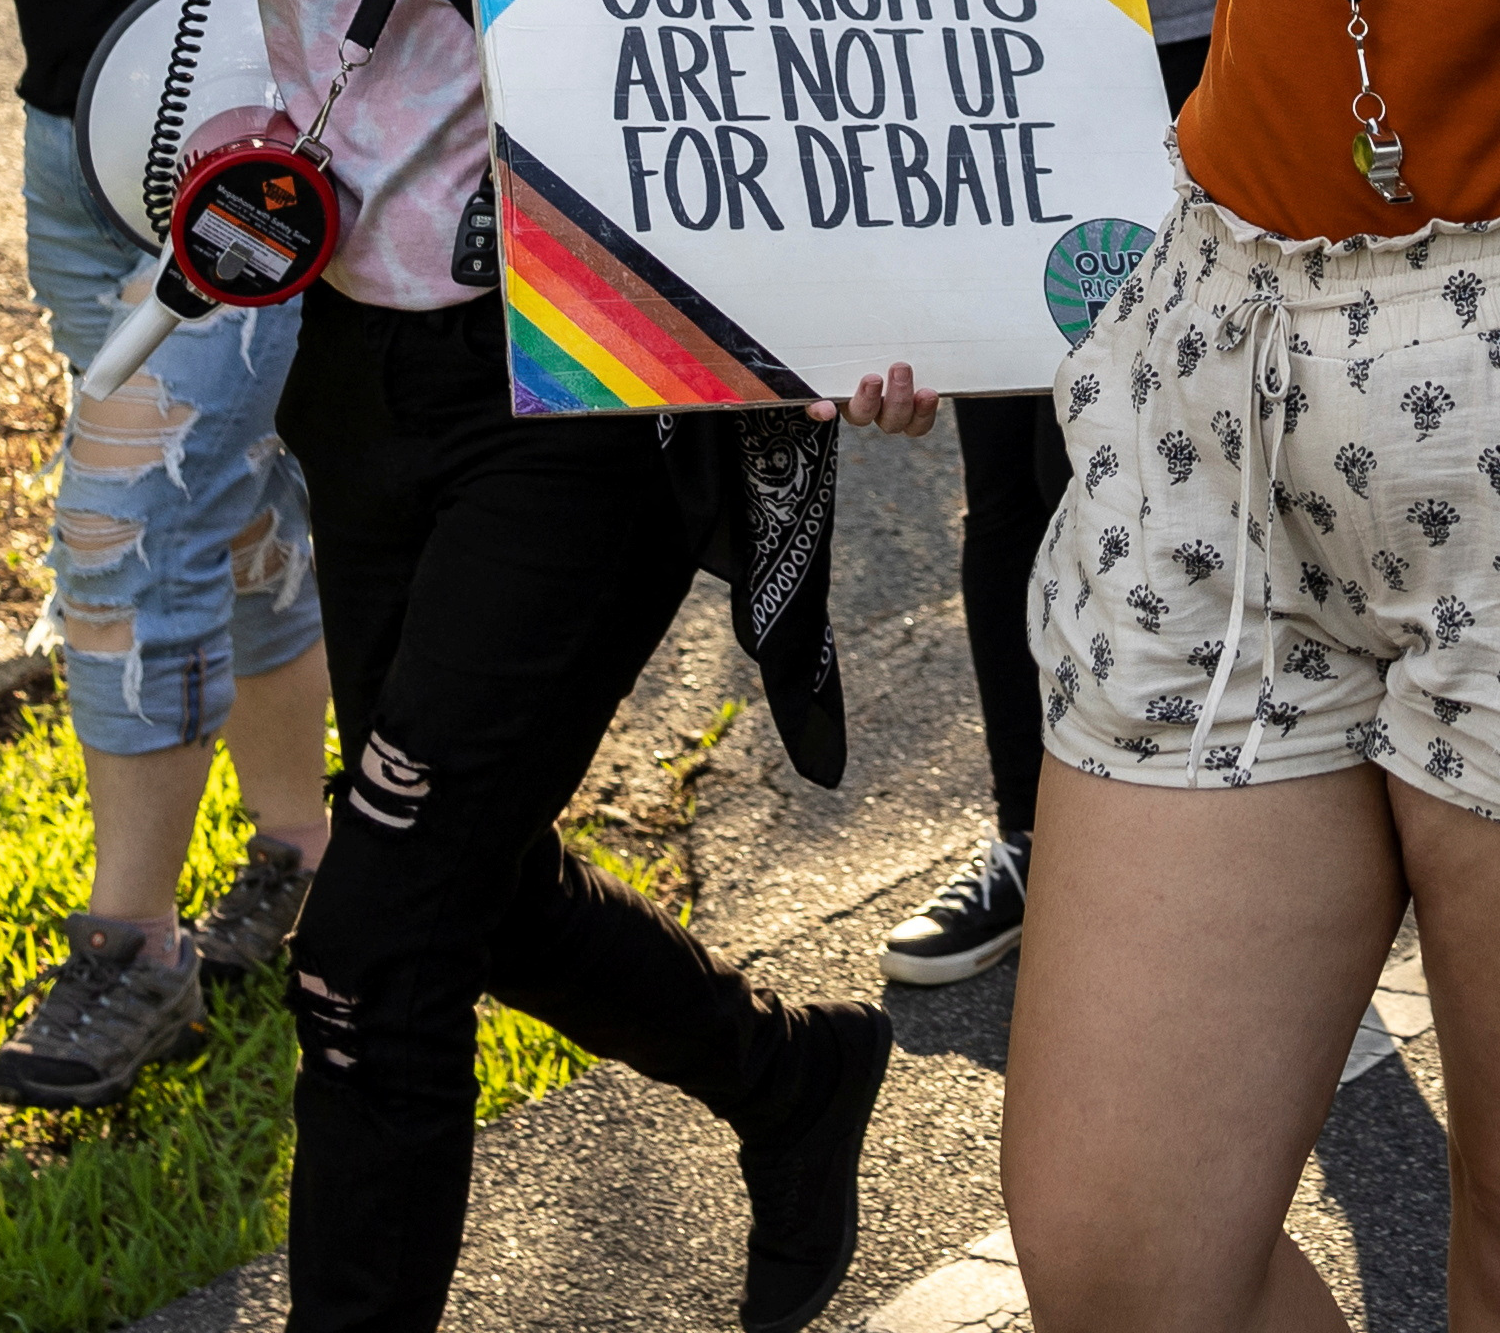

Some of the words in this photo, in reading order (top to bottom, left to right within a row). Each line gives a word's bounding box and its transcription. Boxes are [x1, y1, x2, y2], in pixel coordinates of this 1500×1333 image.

[613, 24, 771, 123] ARE
[771, 26, 936, 122] NOT
[944, 26, 1046, 120] UP
[621, 123, 786, 234] FOR
[790, 121, 1074, 231] DEBATE
